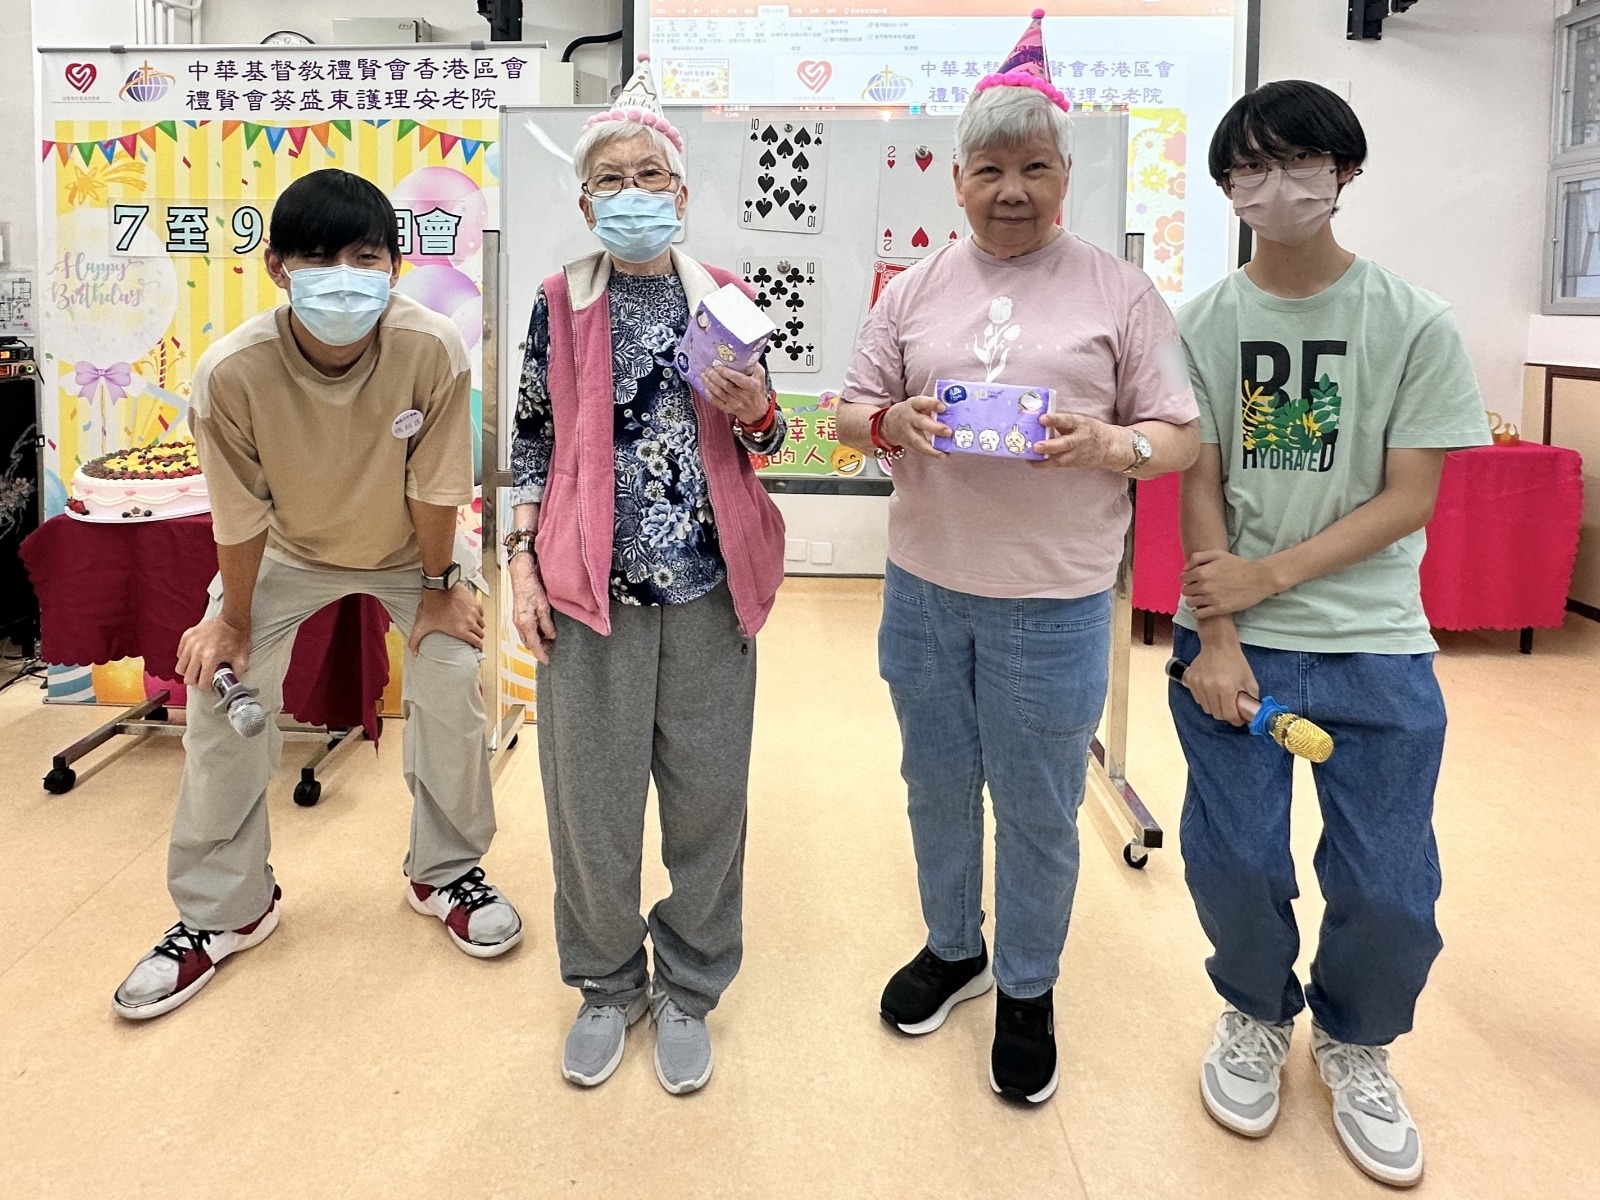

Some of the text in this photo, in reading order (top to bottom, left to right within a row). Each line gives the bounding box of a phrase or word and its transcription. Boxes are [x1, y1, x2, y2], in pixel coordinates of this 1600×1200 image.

[188, 56, 528, 82] 中華基督教禮賢會香港區會
[186, 88, 498, 111] 禮賢會葵盛東護理安老院
[751, 118, 760, 131] 10
[815, 122, 824, 135] 10
[887, 146, 896, 158] 2
[113, 205, 149, 253] 7
[166, 206, 209, 254] 至
[232, 205, 264, 255] 9
[46, 252, 144, 281] Happy
[48, 279, 160, 310] Birthday
[1240, 340, 1348, 448] BE
[1242, 446, 1339, 472] HYDRATED
